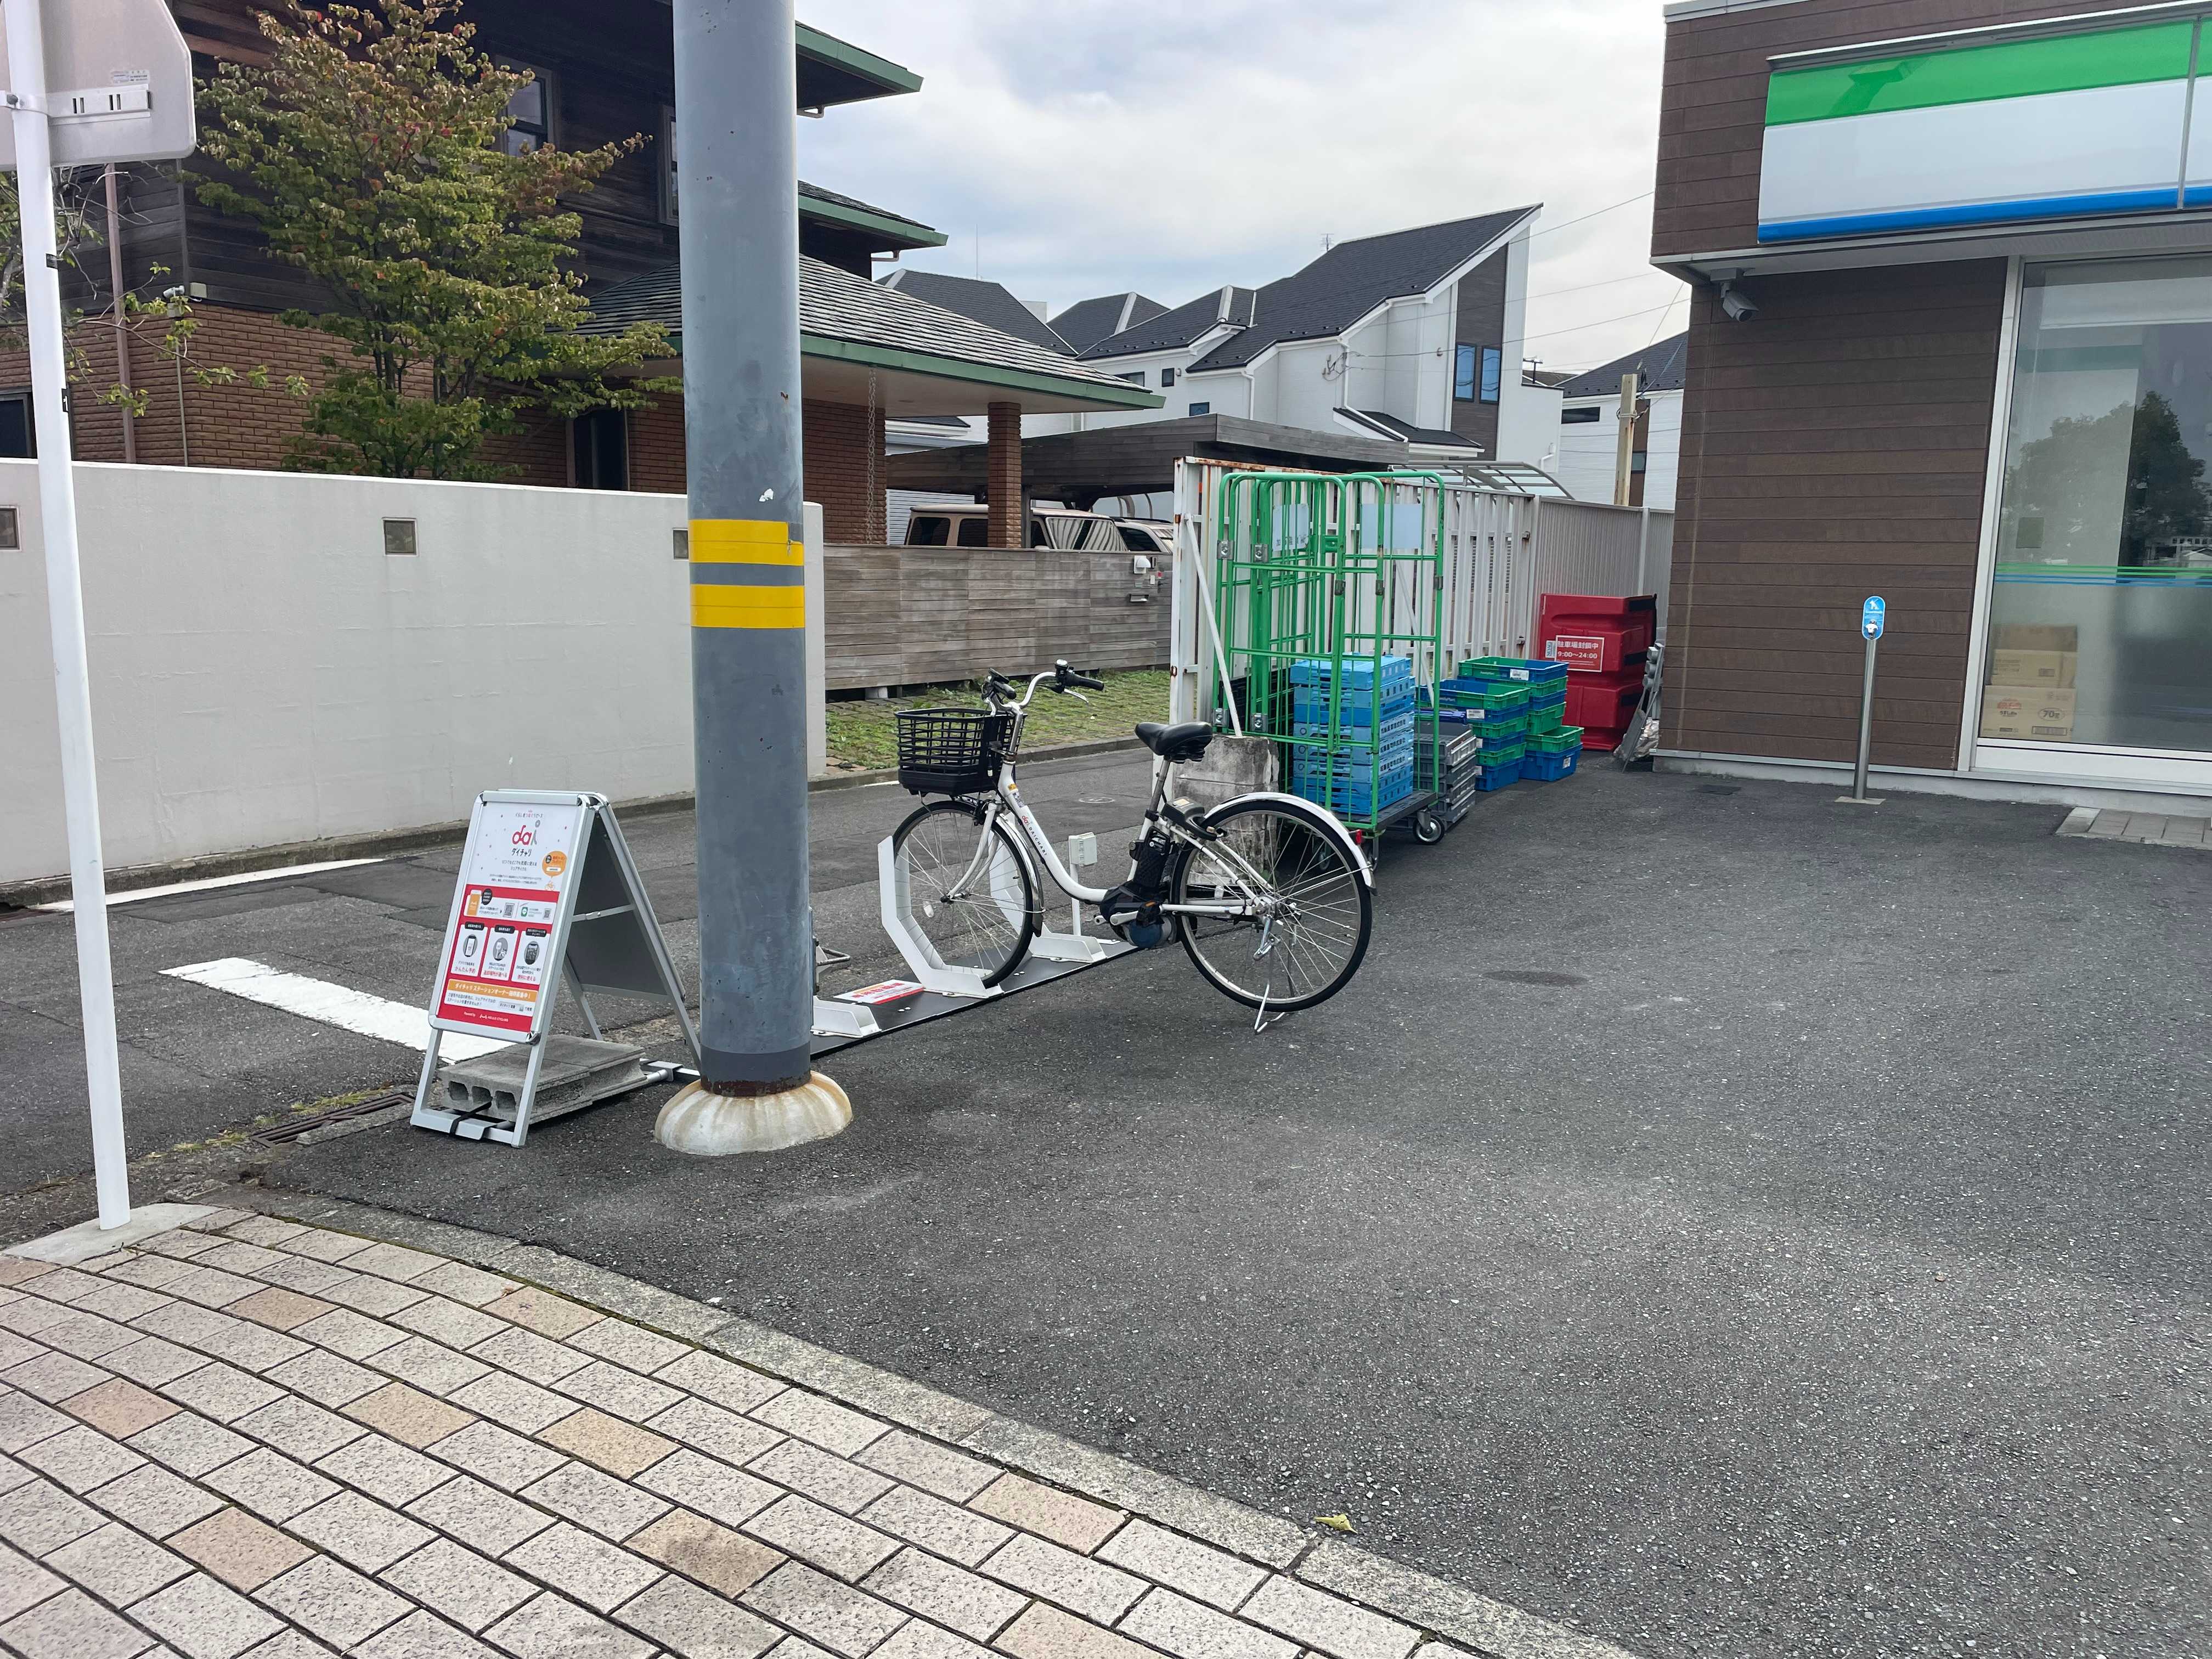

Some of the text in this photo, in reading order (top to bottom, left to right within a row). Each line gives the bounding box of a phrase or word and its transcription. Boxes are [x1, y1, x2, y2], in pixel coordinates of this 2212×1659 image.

[1029, 827, 1047, 856] DAICHARI
[511, 848, 532, 857] ダイチャリ
